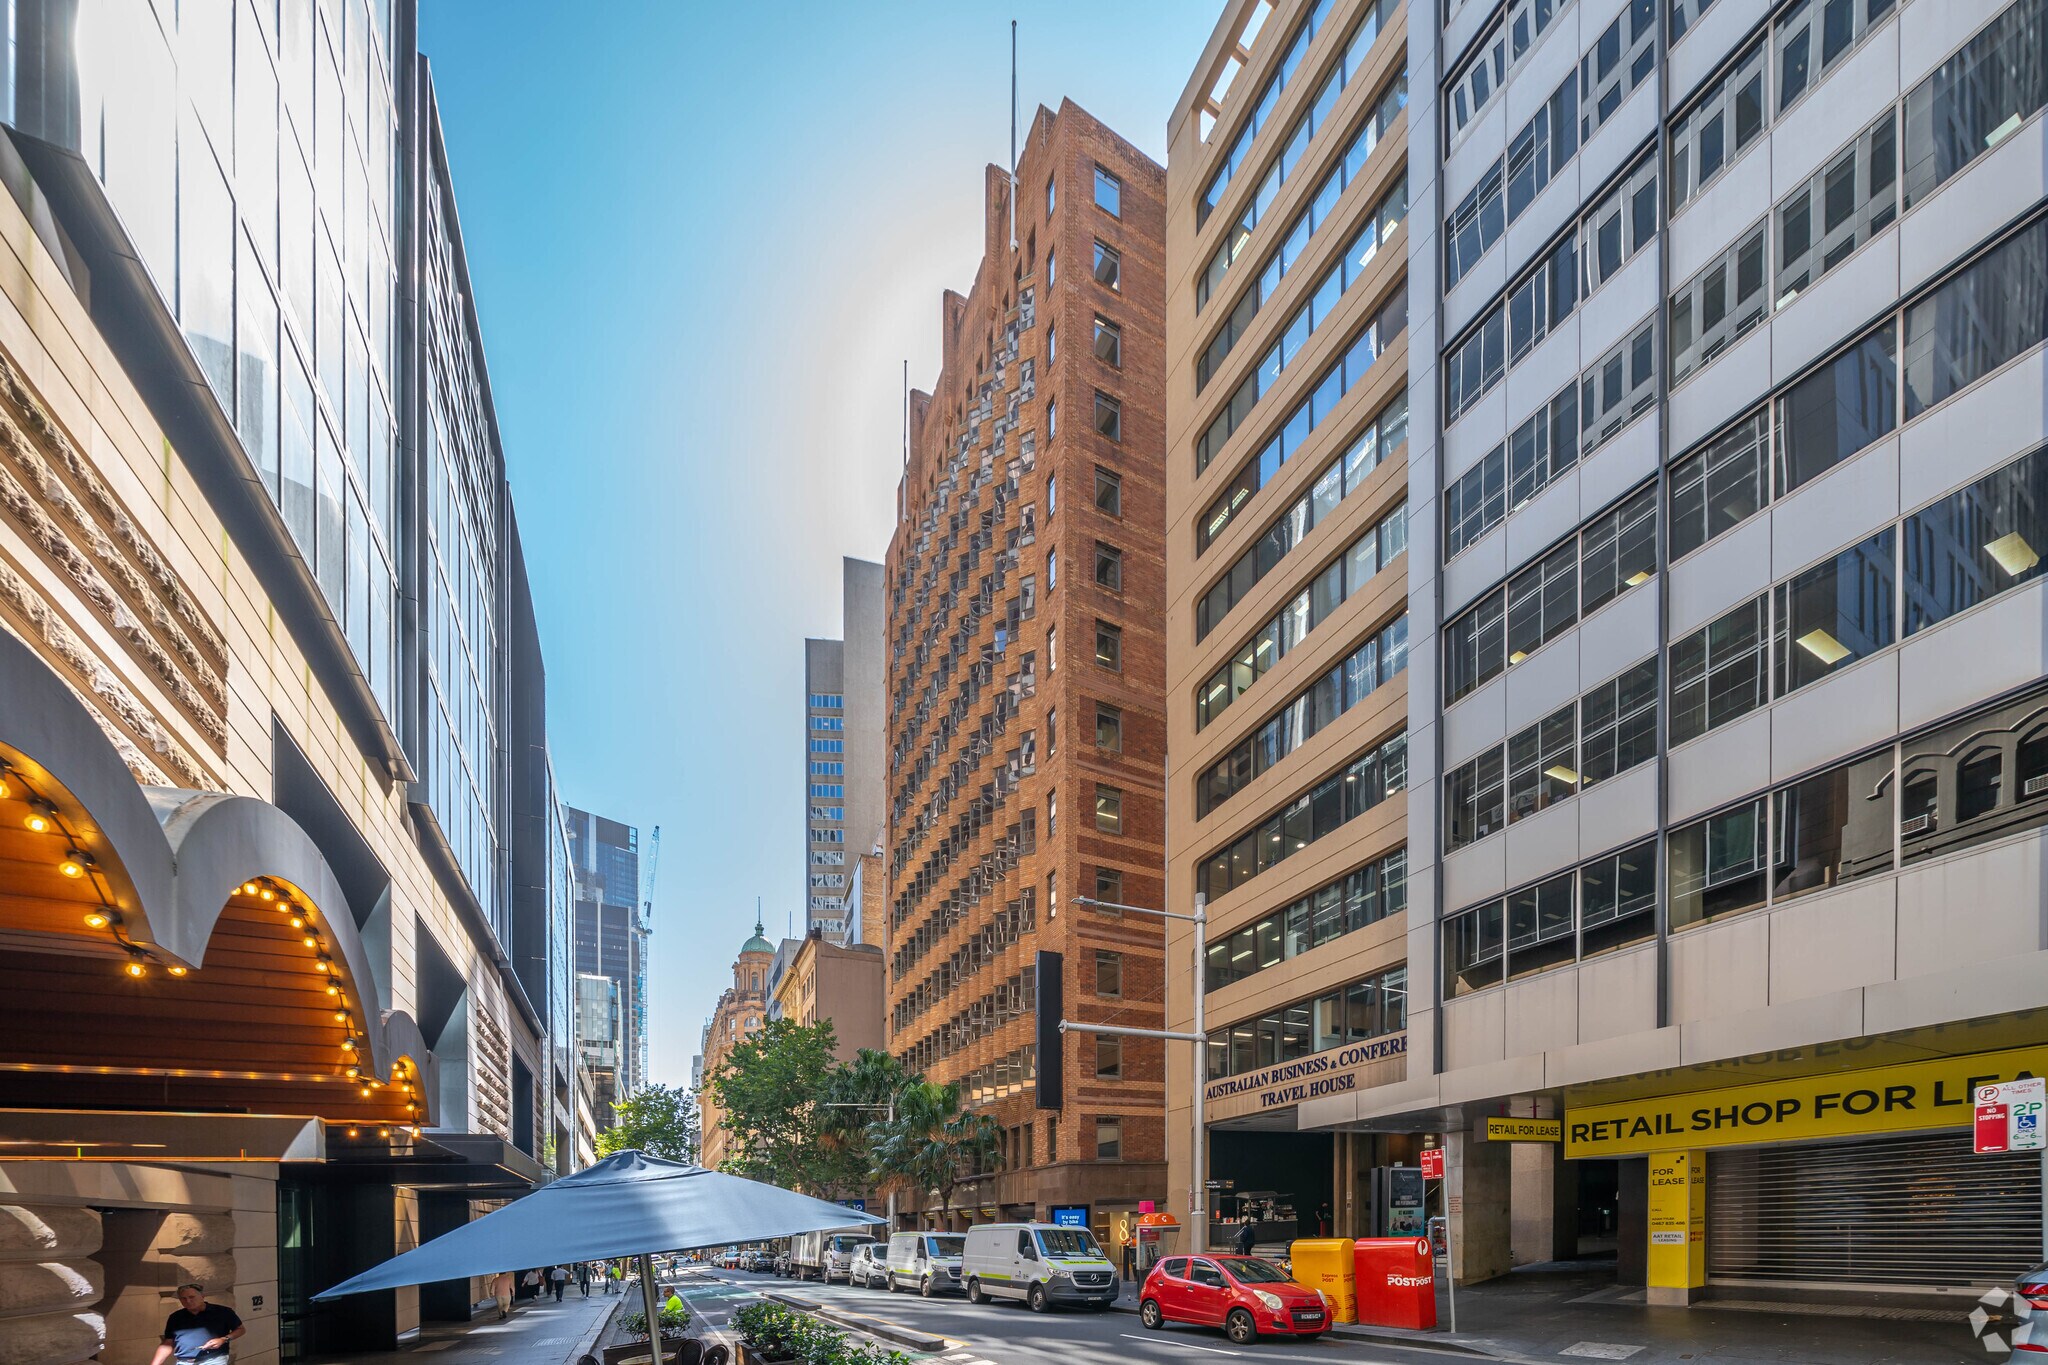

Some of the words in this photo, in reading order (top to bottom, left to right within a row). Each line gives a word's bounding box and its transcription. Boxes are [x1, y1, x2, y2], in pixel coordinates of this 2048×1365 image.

[1206, 1072, 1269, 1100] AUSTRALIAN
[1271, 1056, 1328, 1083] BUSINESS
[1330, 1060, 1337, 1069] &
[1261, 1084, 1307, 1107] TRAVEL
[1310, 1073, 1355, 1097] HOUSE
[1571, 1113, 1685, 1144] RETAIL
[1691, 1098, 1801, 1130] SHOP
[1814, 1085, 1917, 1119] FOR
[2013, 1102, 2042, 1116] 2P
[1489, 1124, 1517, 1135] RETAIL
[1518, 1125, 1535, 1135] FOR
[1536, 1126, 1559, 1136] LEASE
[1652, 1178, 1685, 1186] LEASE
[1387, 1276, 1416, 1287] POST
[1416, 1276, 1432, 1287] POST
